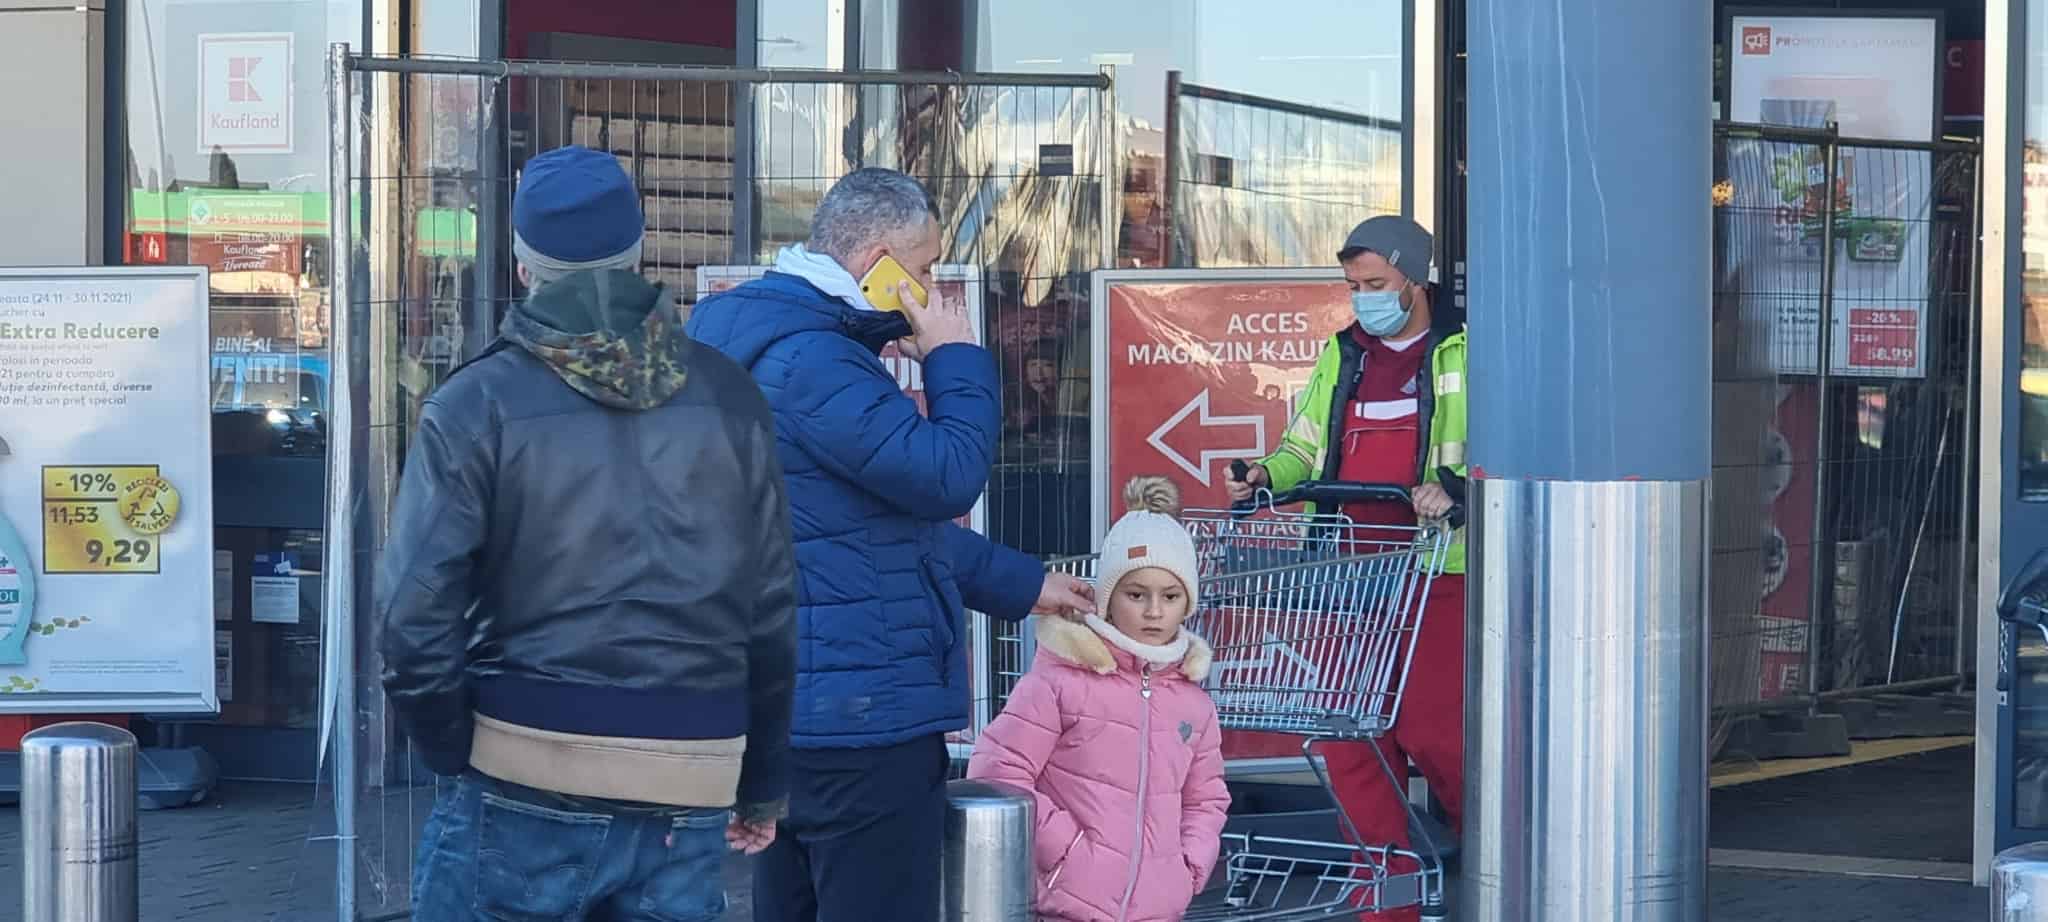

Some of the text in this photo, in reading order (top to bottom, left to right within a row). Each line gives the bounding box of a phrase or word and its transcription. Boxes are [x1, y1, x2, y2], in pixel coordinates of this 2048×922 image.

[210, 112, 280, 128] Kaufland
[1, 322, 160, 339] Extra Reducere
[1227, 313, 1308, 334] ACCES
[215, 336, 250, 352] BINE
[1127, 342, 1253, 366] MAGAZIN
[42, 356, 93, 369] perioada
[15, 370, 52, 381] pentru
[112, 383, 153, 392] diverse
[88, 395, 127, 407] special
[70, 473, 117, 493] 19%
[50, 506, 99, 525] 11,53
[85, 538, 151, 567] 9,29
